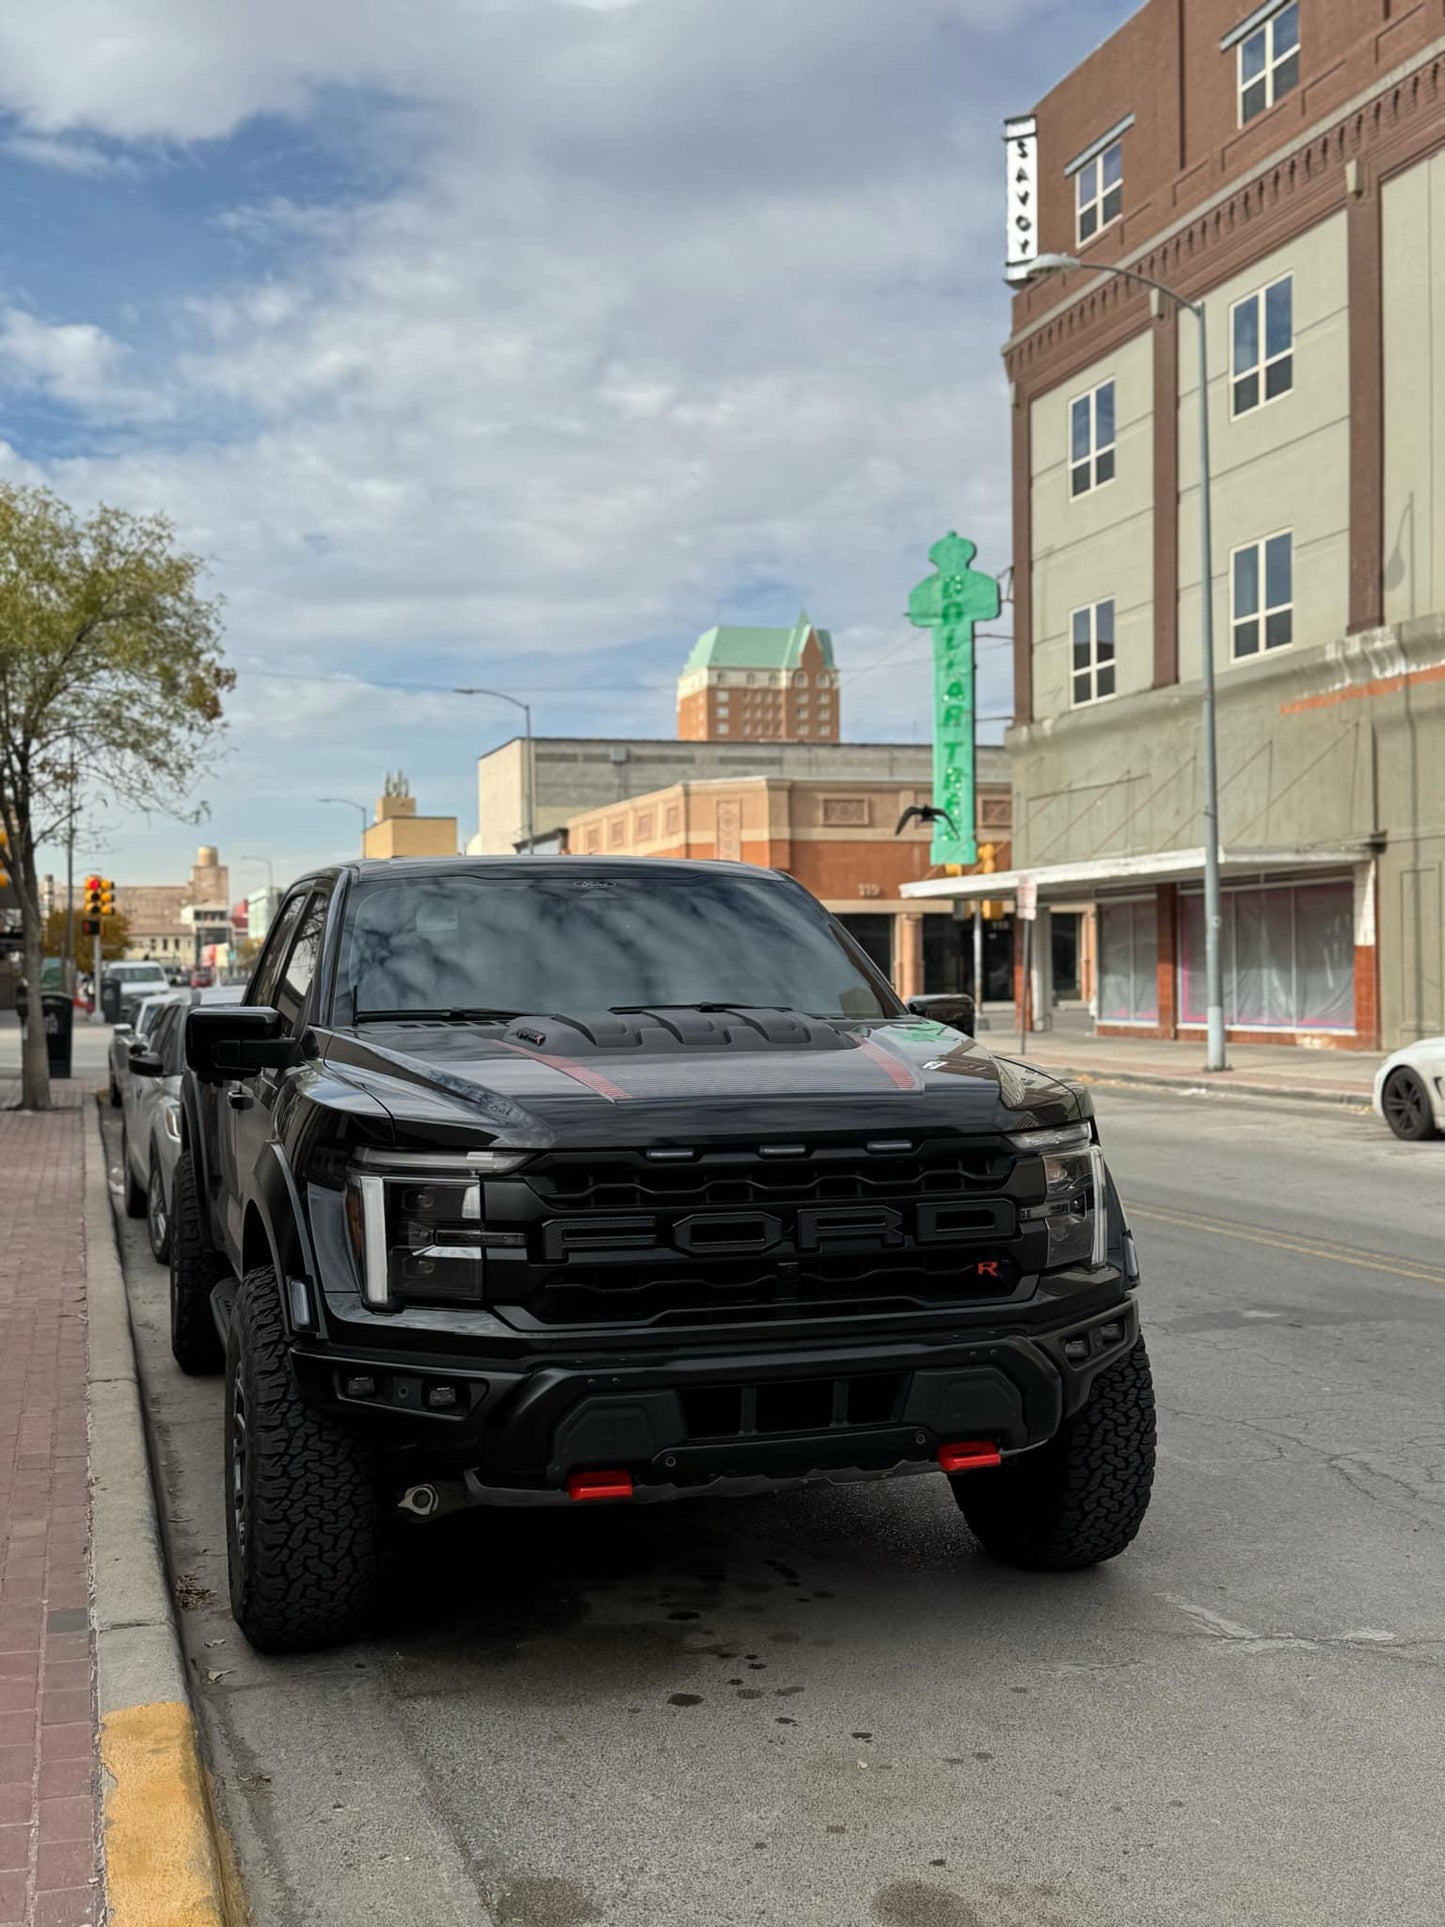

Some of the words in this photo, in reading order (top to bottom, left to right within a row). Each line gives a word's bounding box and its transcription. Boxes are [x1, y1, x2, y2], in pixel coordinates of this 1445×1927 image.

[1014, 139, 1032, 255] SAVOY
[541, 1199, 1015, 1260] FORD
[977, 1261, 999, 1277] R
